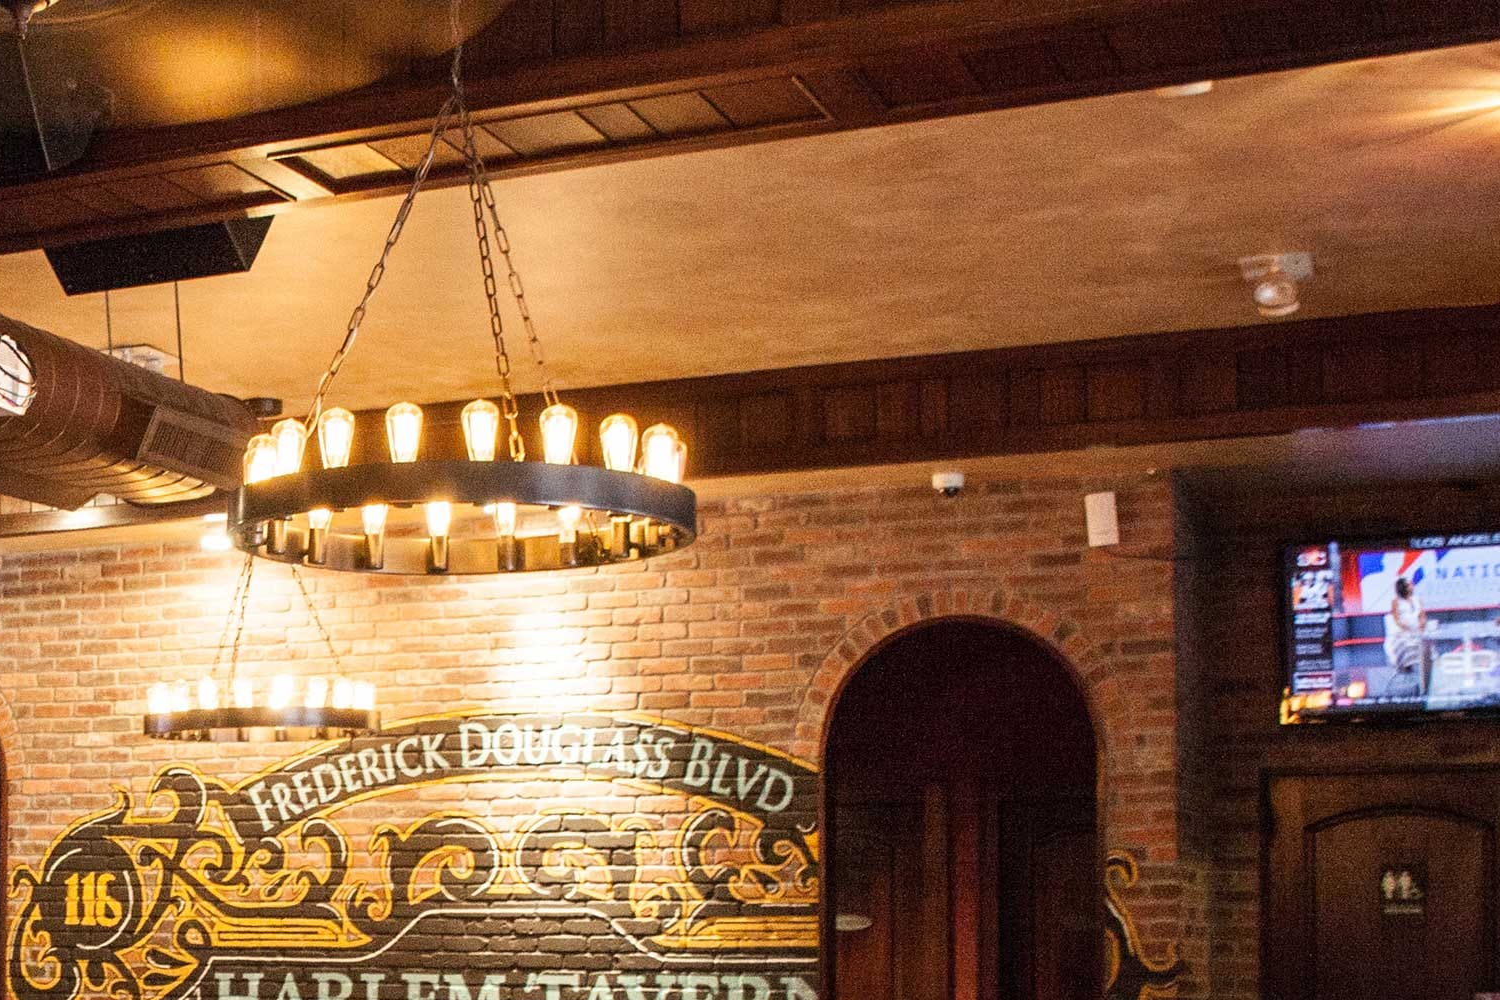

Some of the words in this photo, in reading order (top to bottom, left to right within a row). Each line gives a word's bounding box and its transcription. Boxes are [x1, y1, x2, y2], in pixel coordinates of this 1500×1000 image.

[247, 733, 449, 833] FREDERICK
[459, 722, 675, 779] DOUGLASS
[684, 738, 794, 812] BLVD
[64, 871, 122, 928] 116
